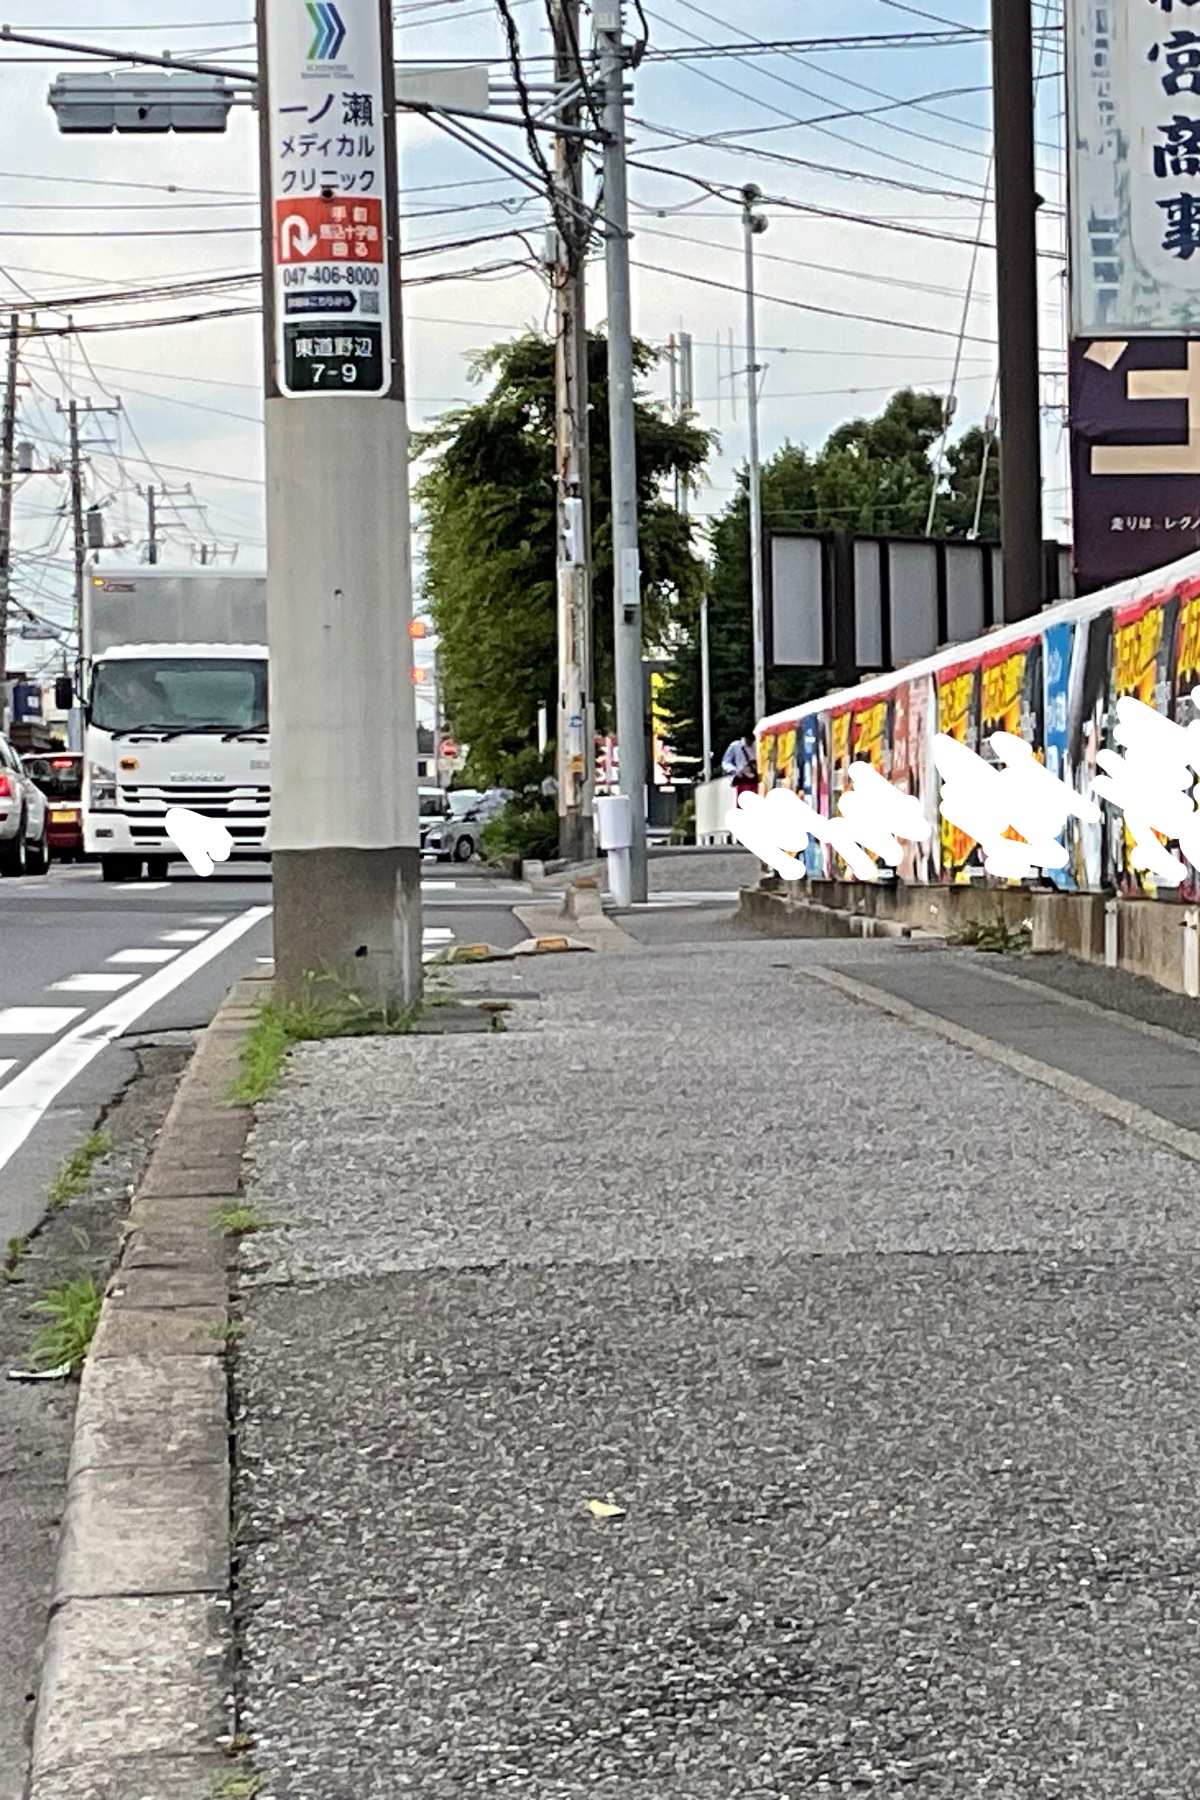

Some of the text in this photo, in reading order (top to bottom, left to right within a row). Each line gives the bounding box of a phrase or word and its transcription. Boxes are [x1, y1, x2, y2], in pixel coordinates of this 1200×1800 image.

[279, 91, 374, 127] 一ノ瀬
[280, 133, 375, 159] メディカル
[281, 168, 375, 193] クリニック
[310, 363, 358, 383] 7-9
